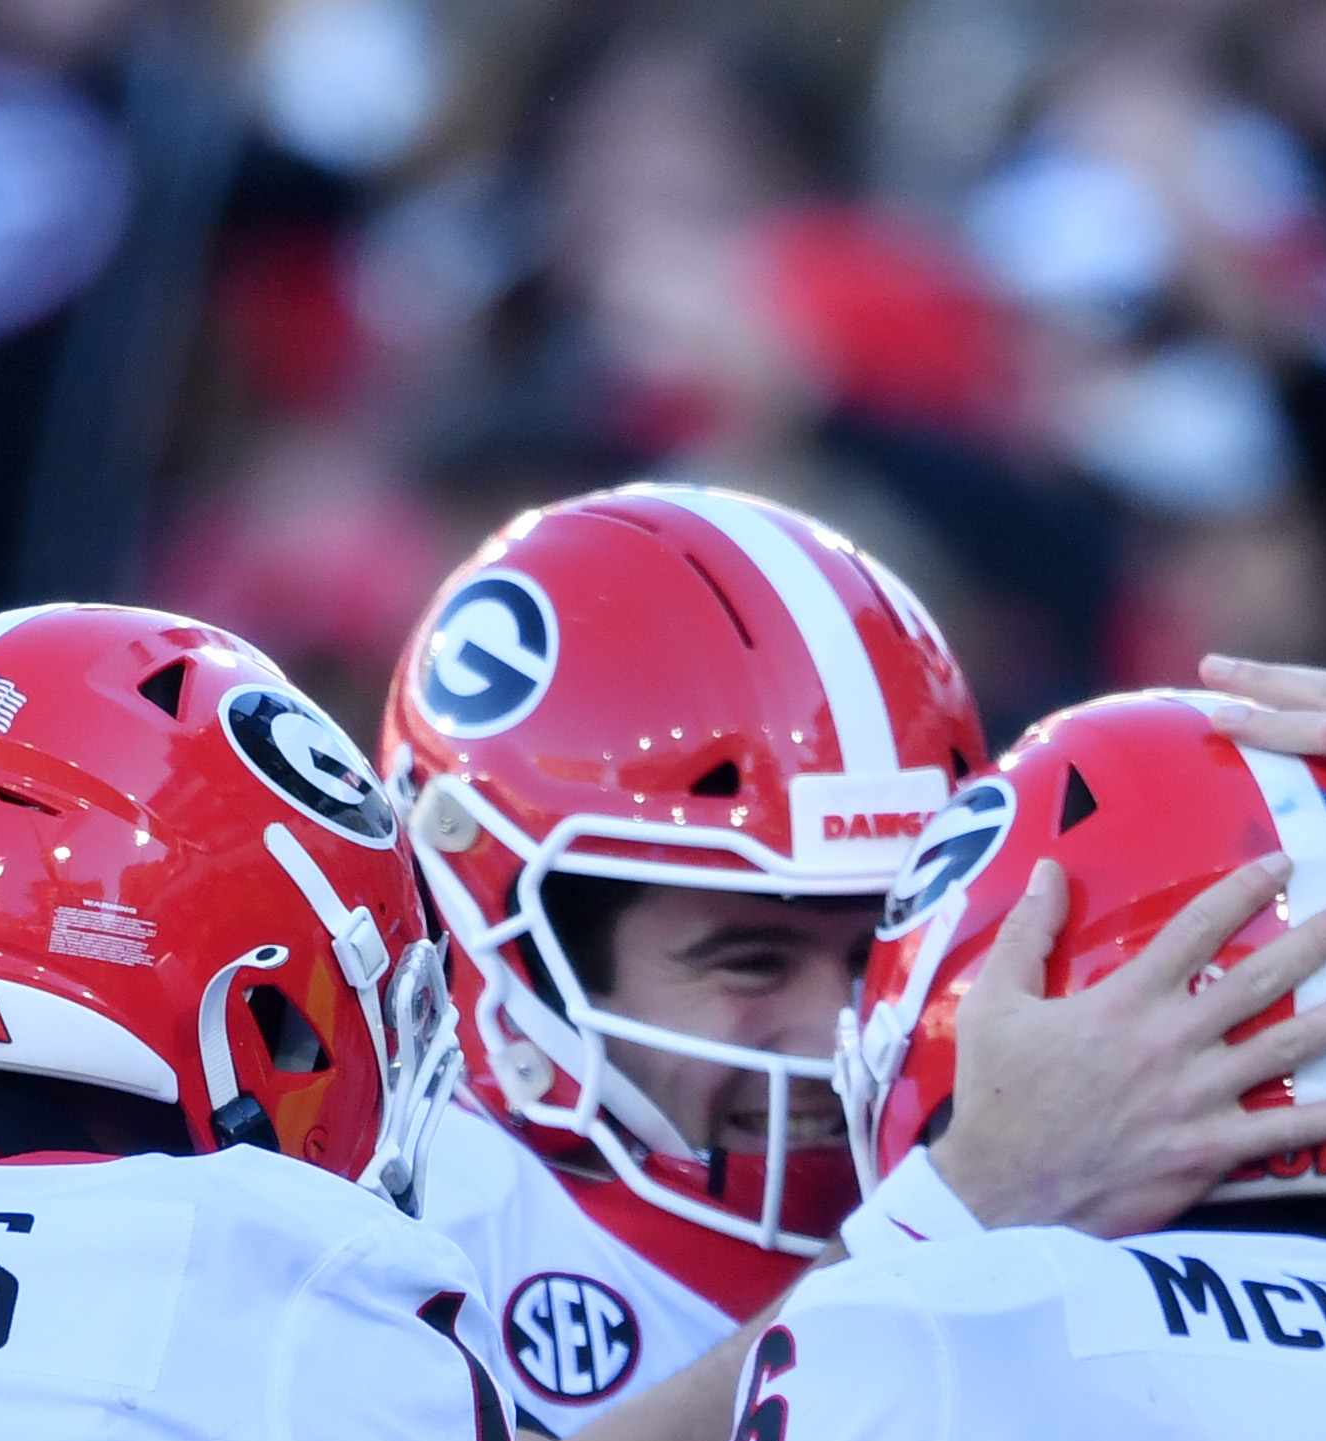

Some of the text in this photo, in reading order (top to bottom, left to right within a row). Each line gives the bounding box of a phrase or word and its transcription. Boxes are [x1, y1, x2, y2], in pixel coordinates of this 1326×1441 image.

[425, 578, 548, 724] G
[227, 690, 394, 840] G
[822, 812, 938, 840] DAWG
[511, 1276, 631, 1394] SEC
